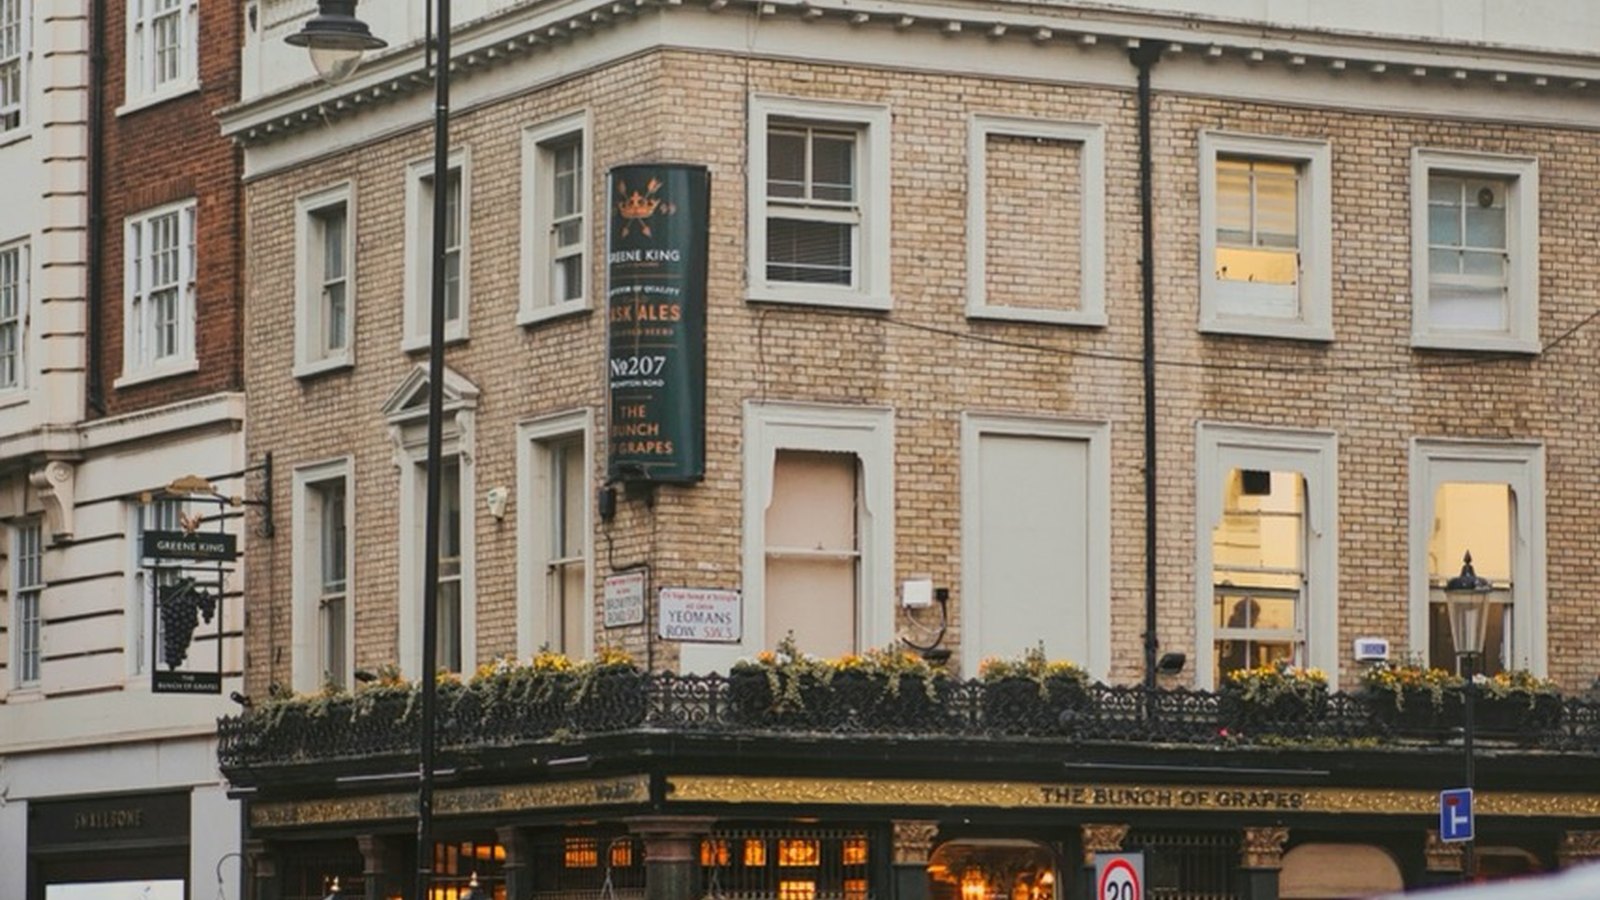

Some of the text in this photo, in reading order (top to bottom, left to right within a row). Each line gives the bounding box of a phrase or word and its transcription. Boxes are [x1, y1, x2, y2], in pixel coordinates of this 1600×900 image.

[609, 249, 680, 263] REENE KING
[636, 304, 680, 322] ALES
[621, 405, 646, 418] THE
[156, 540, 225, 553] GREENE KING
[667, 610, 732, 625] YEOMANS
[665, 624, 697, 637] ROW
[1041, 787, 1303, 809] THE BUNCH OF GRAPES
[1106, 880, 1134, 900] 20
